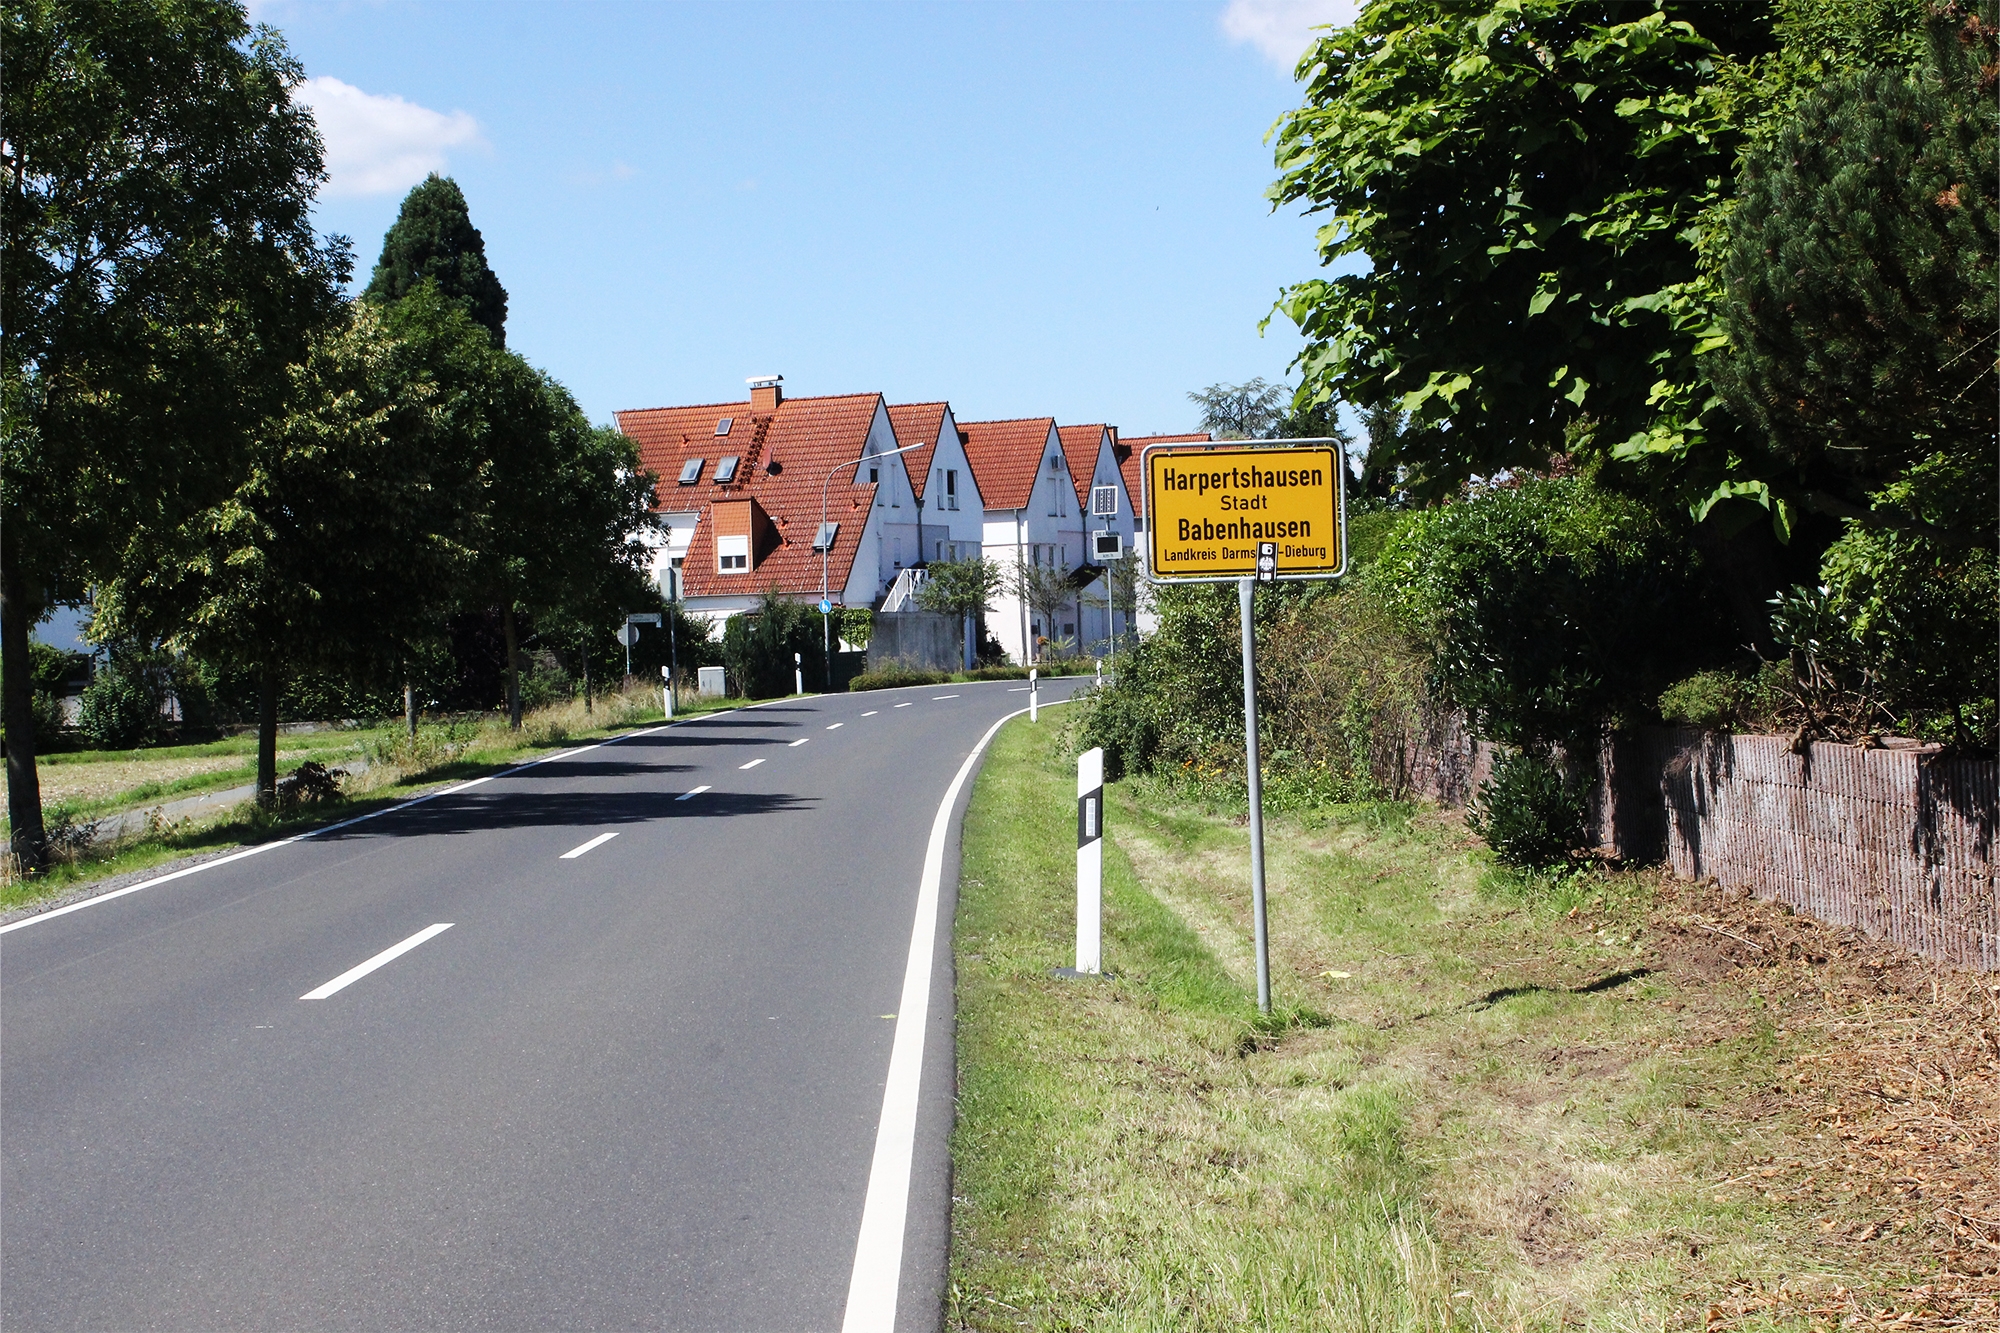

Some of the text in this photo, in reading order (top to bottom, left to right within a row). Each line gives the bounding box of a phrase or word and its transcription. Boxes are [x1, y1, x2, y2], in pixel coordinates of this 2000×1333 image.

[1163, 465, 1323, 495] Harpertshausen
[1220, 494, 1268, 511] Stadt
[1178, 516, 1311, 541] Babenhausen
[1164, 547, 1217, 562] Landkreis
